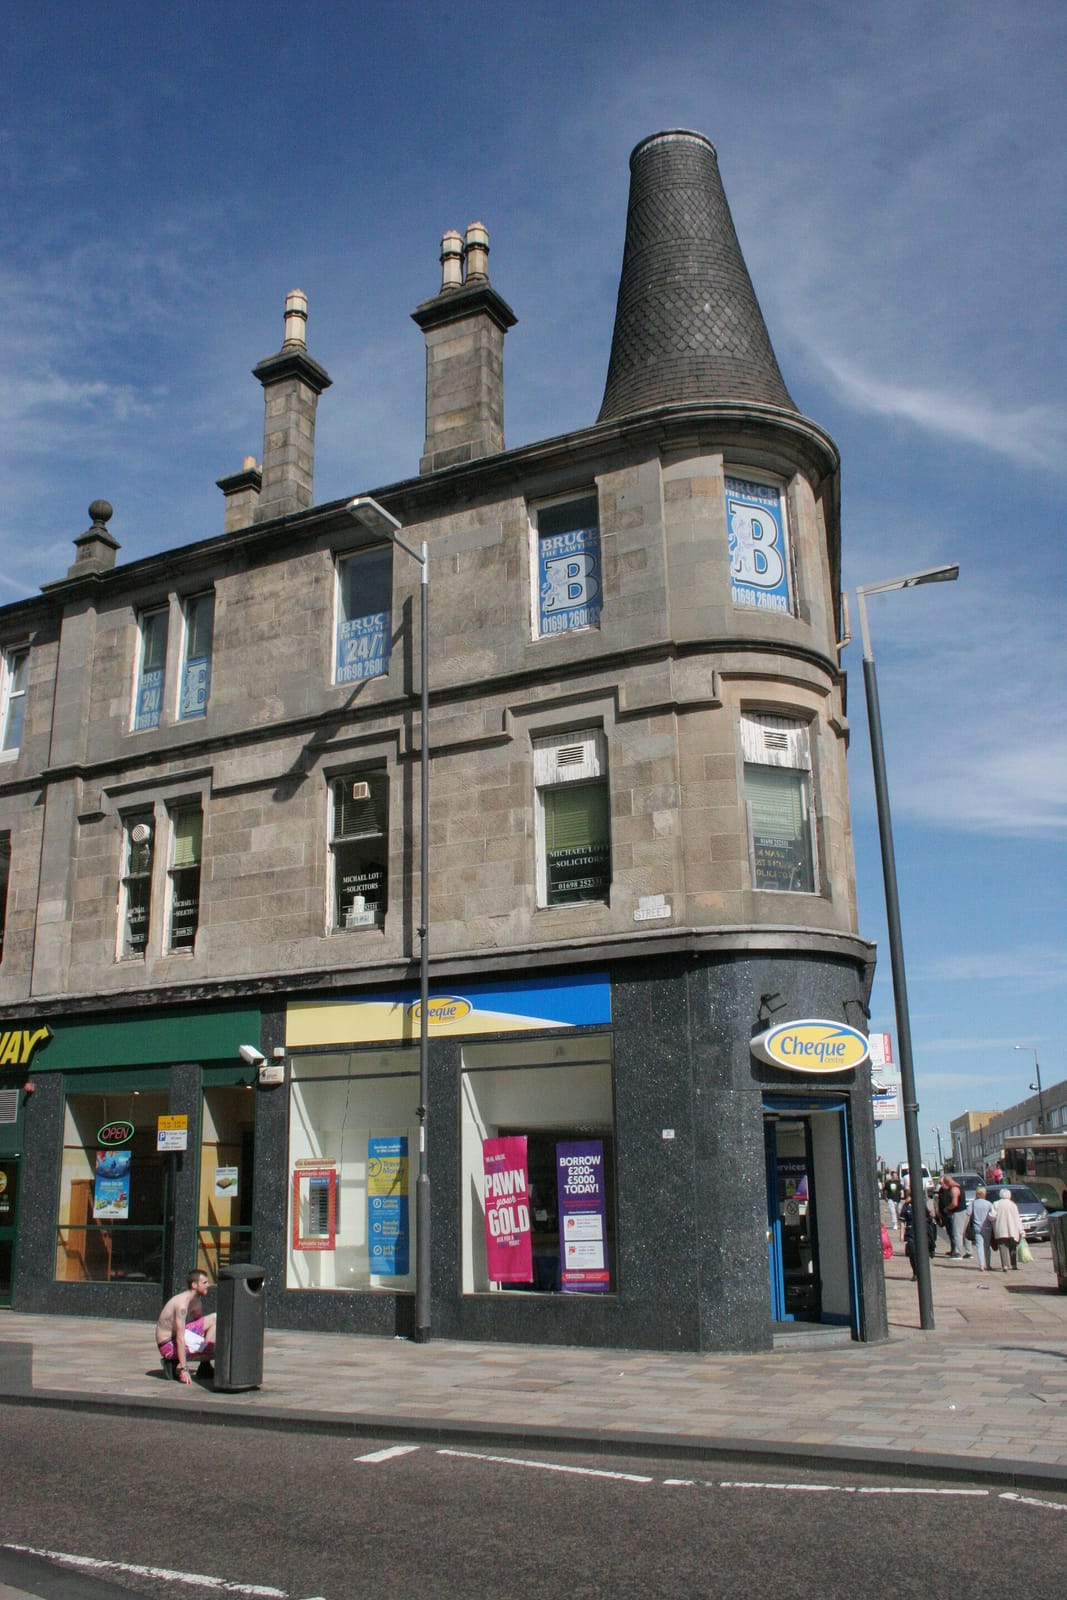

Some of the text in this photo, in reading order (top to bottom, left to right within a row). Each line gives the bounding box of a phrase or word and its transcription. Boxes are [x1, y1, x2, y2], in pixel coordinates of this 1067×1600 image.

[726, 479, 777, 499] BRUCE
[742, 492, 778, 506] LAWYERS
[732, 586, 756, 605] 01698
[341, 612, 385, 633] BRUC
[543, 612, 567, 633] 01698
[550, 846, 587, 857] MICHAEL
[415, 1006, 457, 1020] Ceque
[781, 1036, 846, 1063] Cheque
[101, 1127, 130, 1140] OPEN
[560, 1155, 601, 1167] BORROW
[484, 1169, 526, 1198] PAWN
[563, 1183, 600, 1194] TODAY!
[496, 1195, 517, 1210] your
[488, 1204, 530, 1237] GOLD
